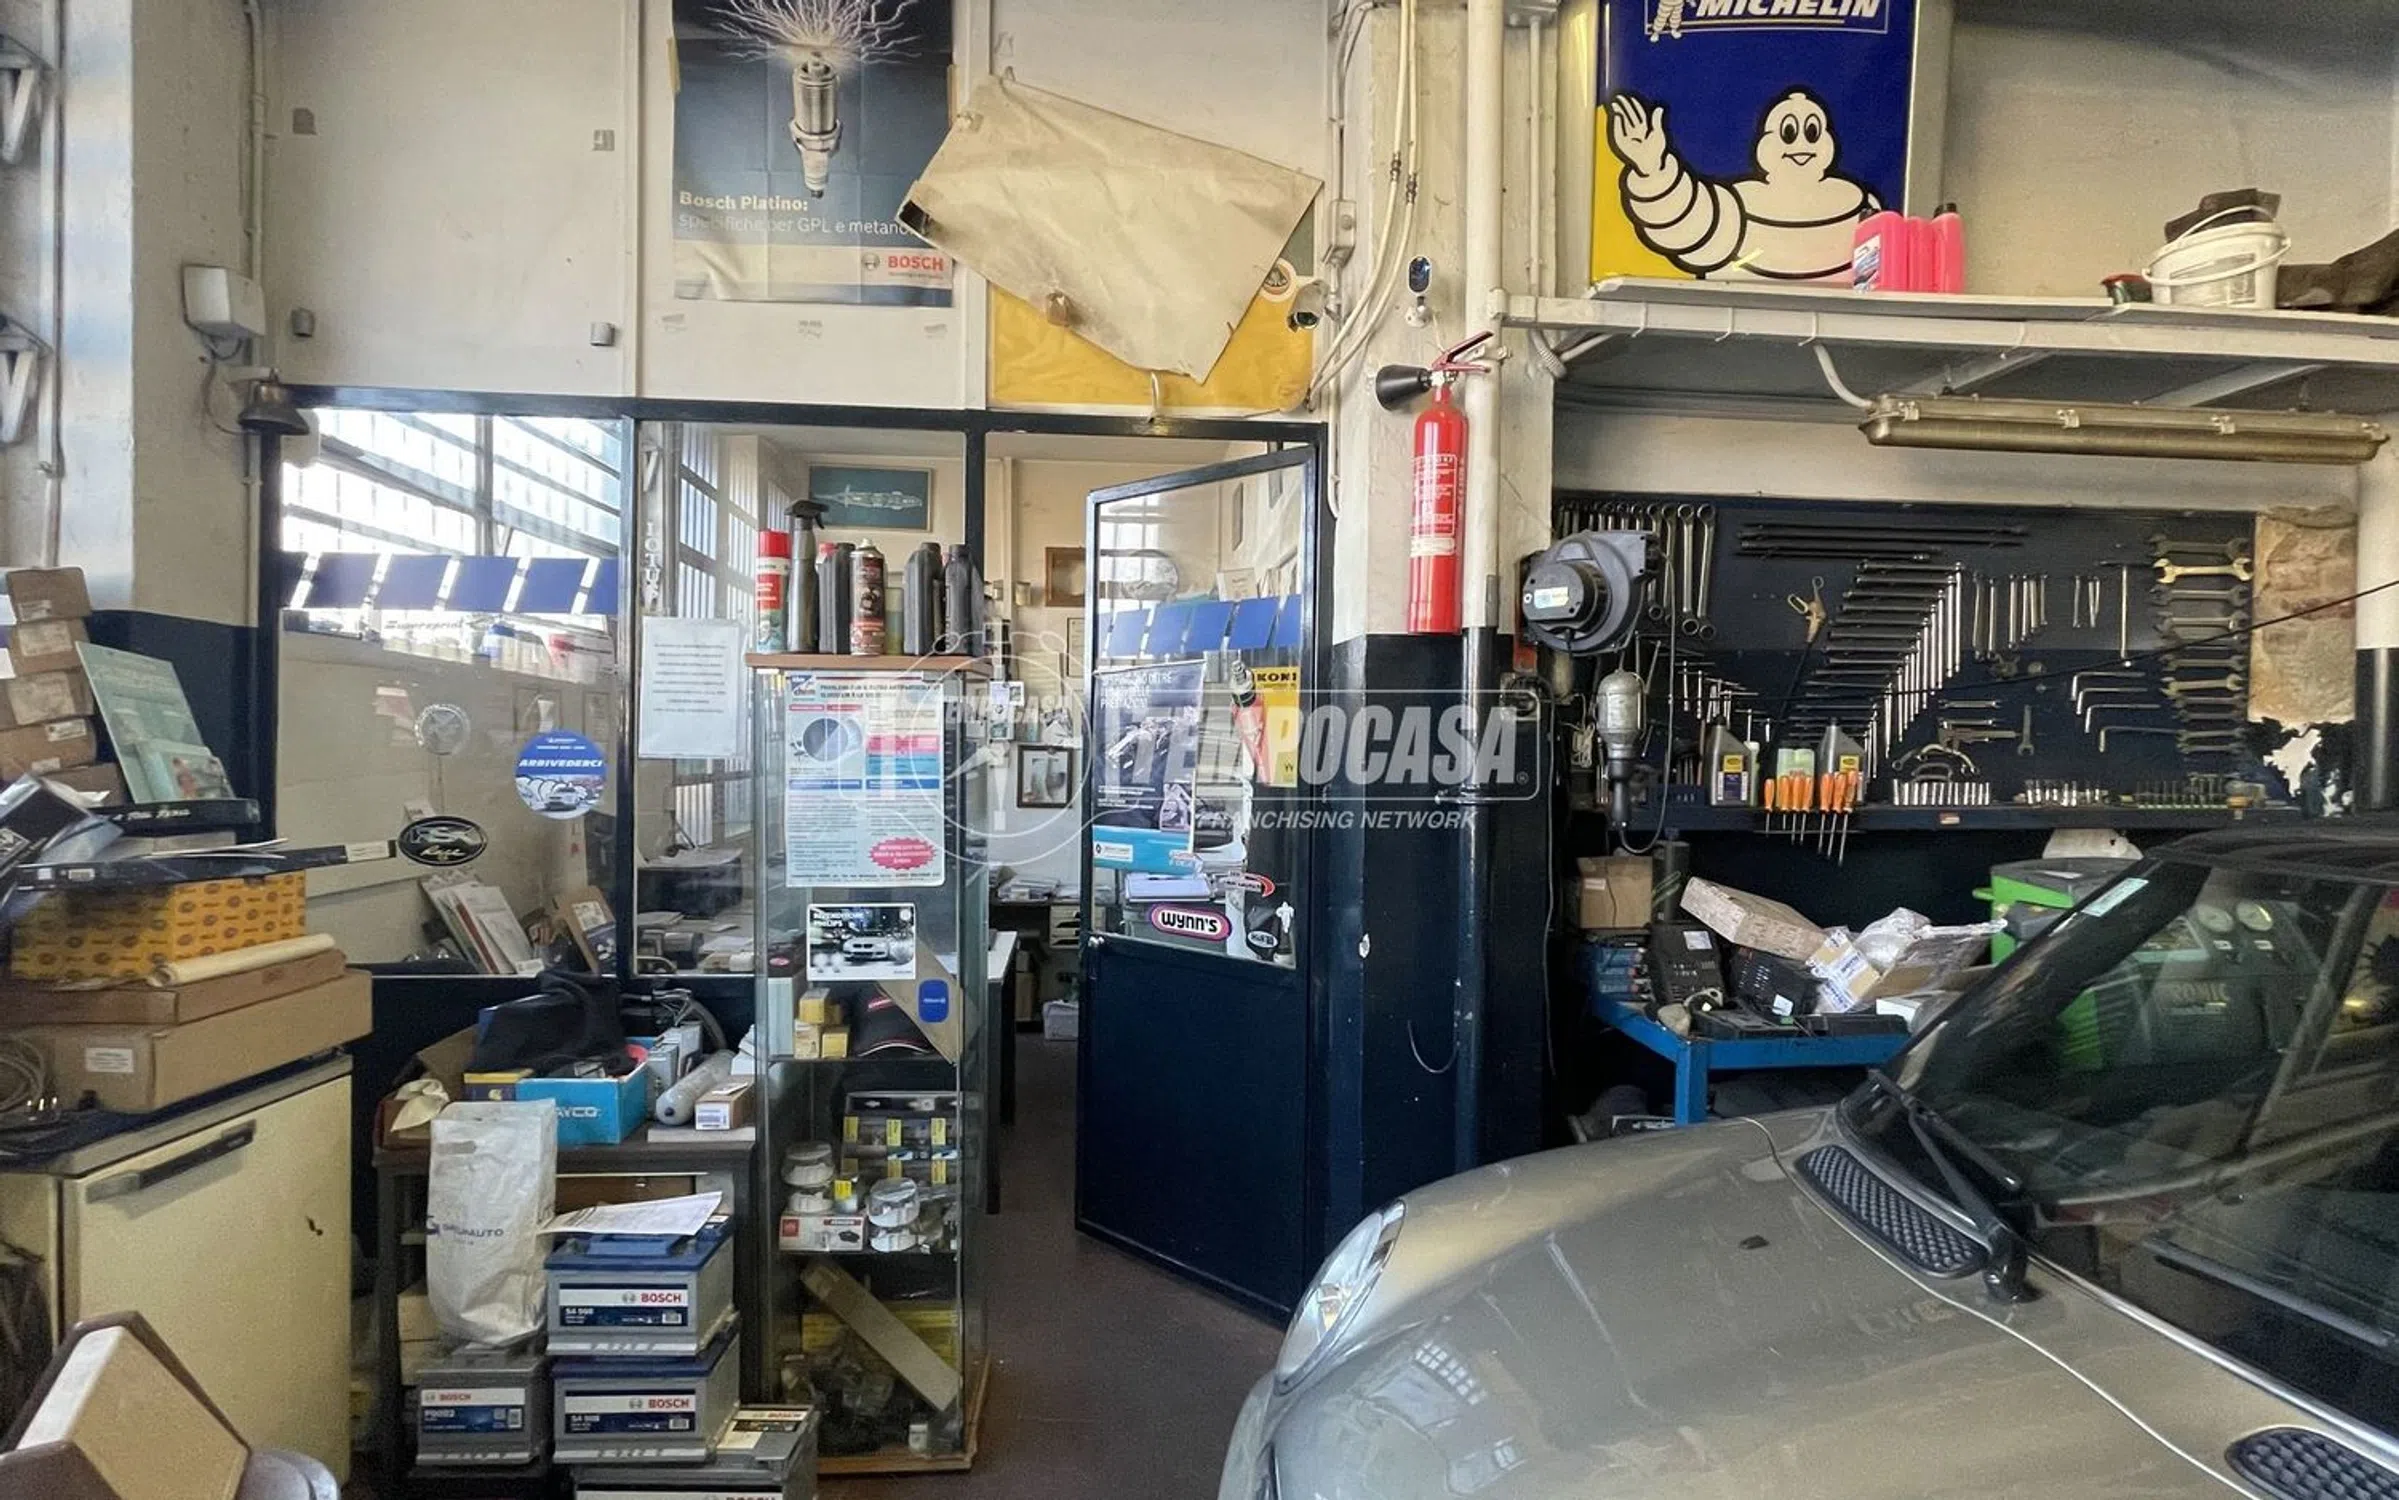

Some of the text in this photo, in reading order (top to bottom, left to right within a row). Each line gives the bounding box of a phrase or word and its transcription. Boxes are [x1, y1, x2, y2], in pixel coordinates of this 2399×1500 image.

[1696, 0, 1879, 18] MICHELIN
[679, 191, 808, 212] Bosch Platino:
[797, 219, 830, 233] GPL
[835, 222, 844, 233] e
[888, 255, 944, 271] BOSCH
[519, 759, 603, 768] ARRIVEDERCI
[554, 1106, 598, 1118] AYCO
[641, 1293, 682, 1303] BOSCH
[440, 1392, 472, 1401] BOSCH
[648, 1398, 690, 1409] BOSCH
